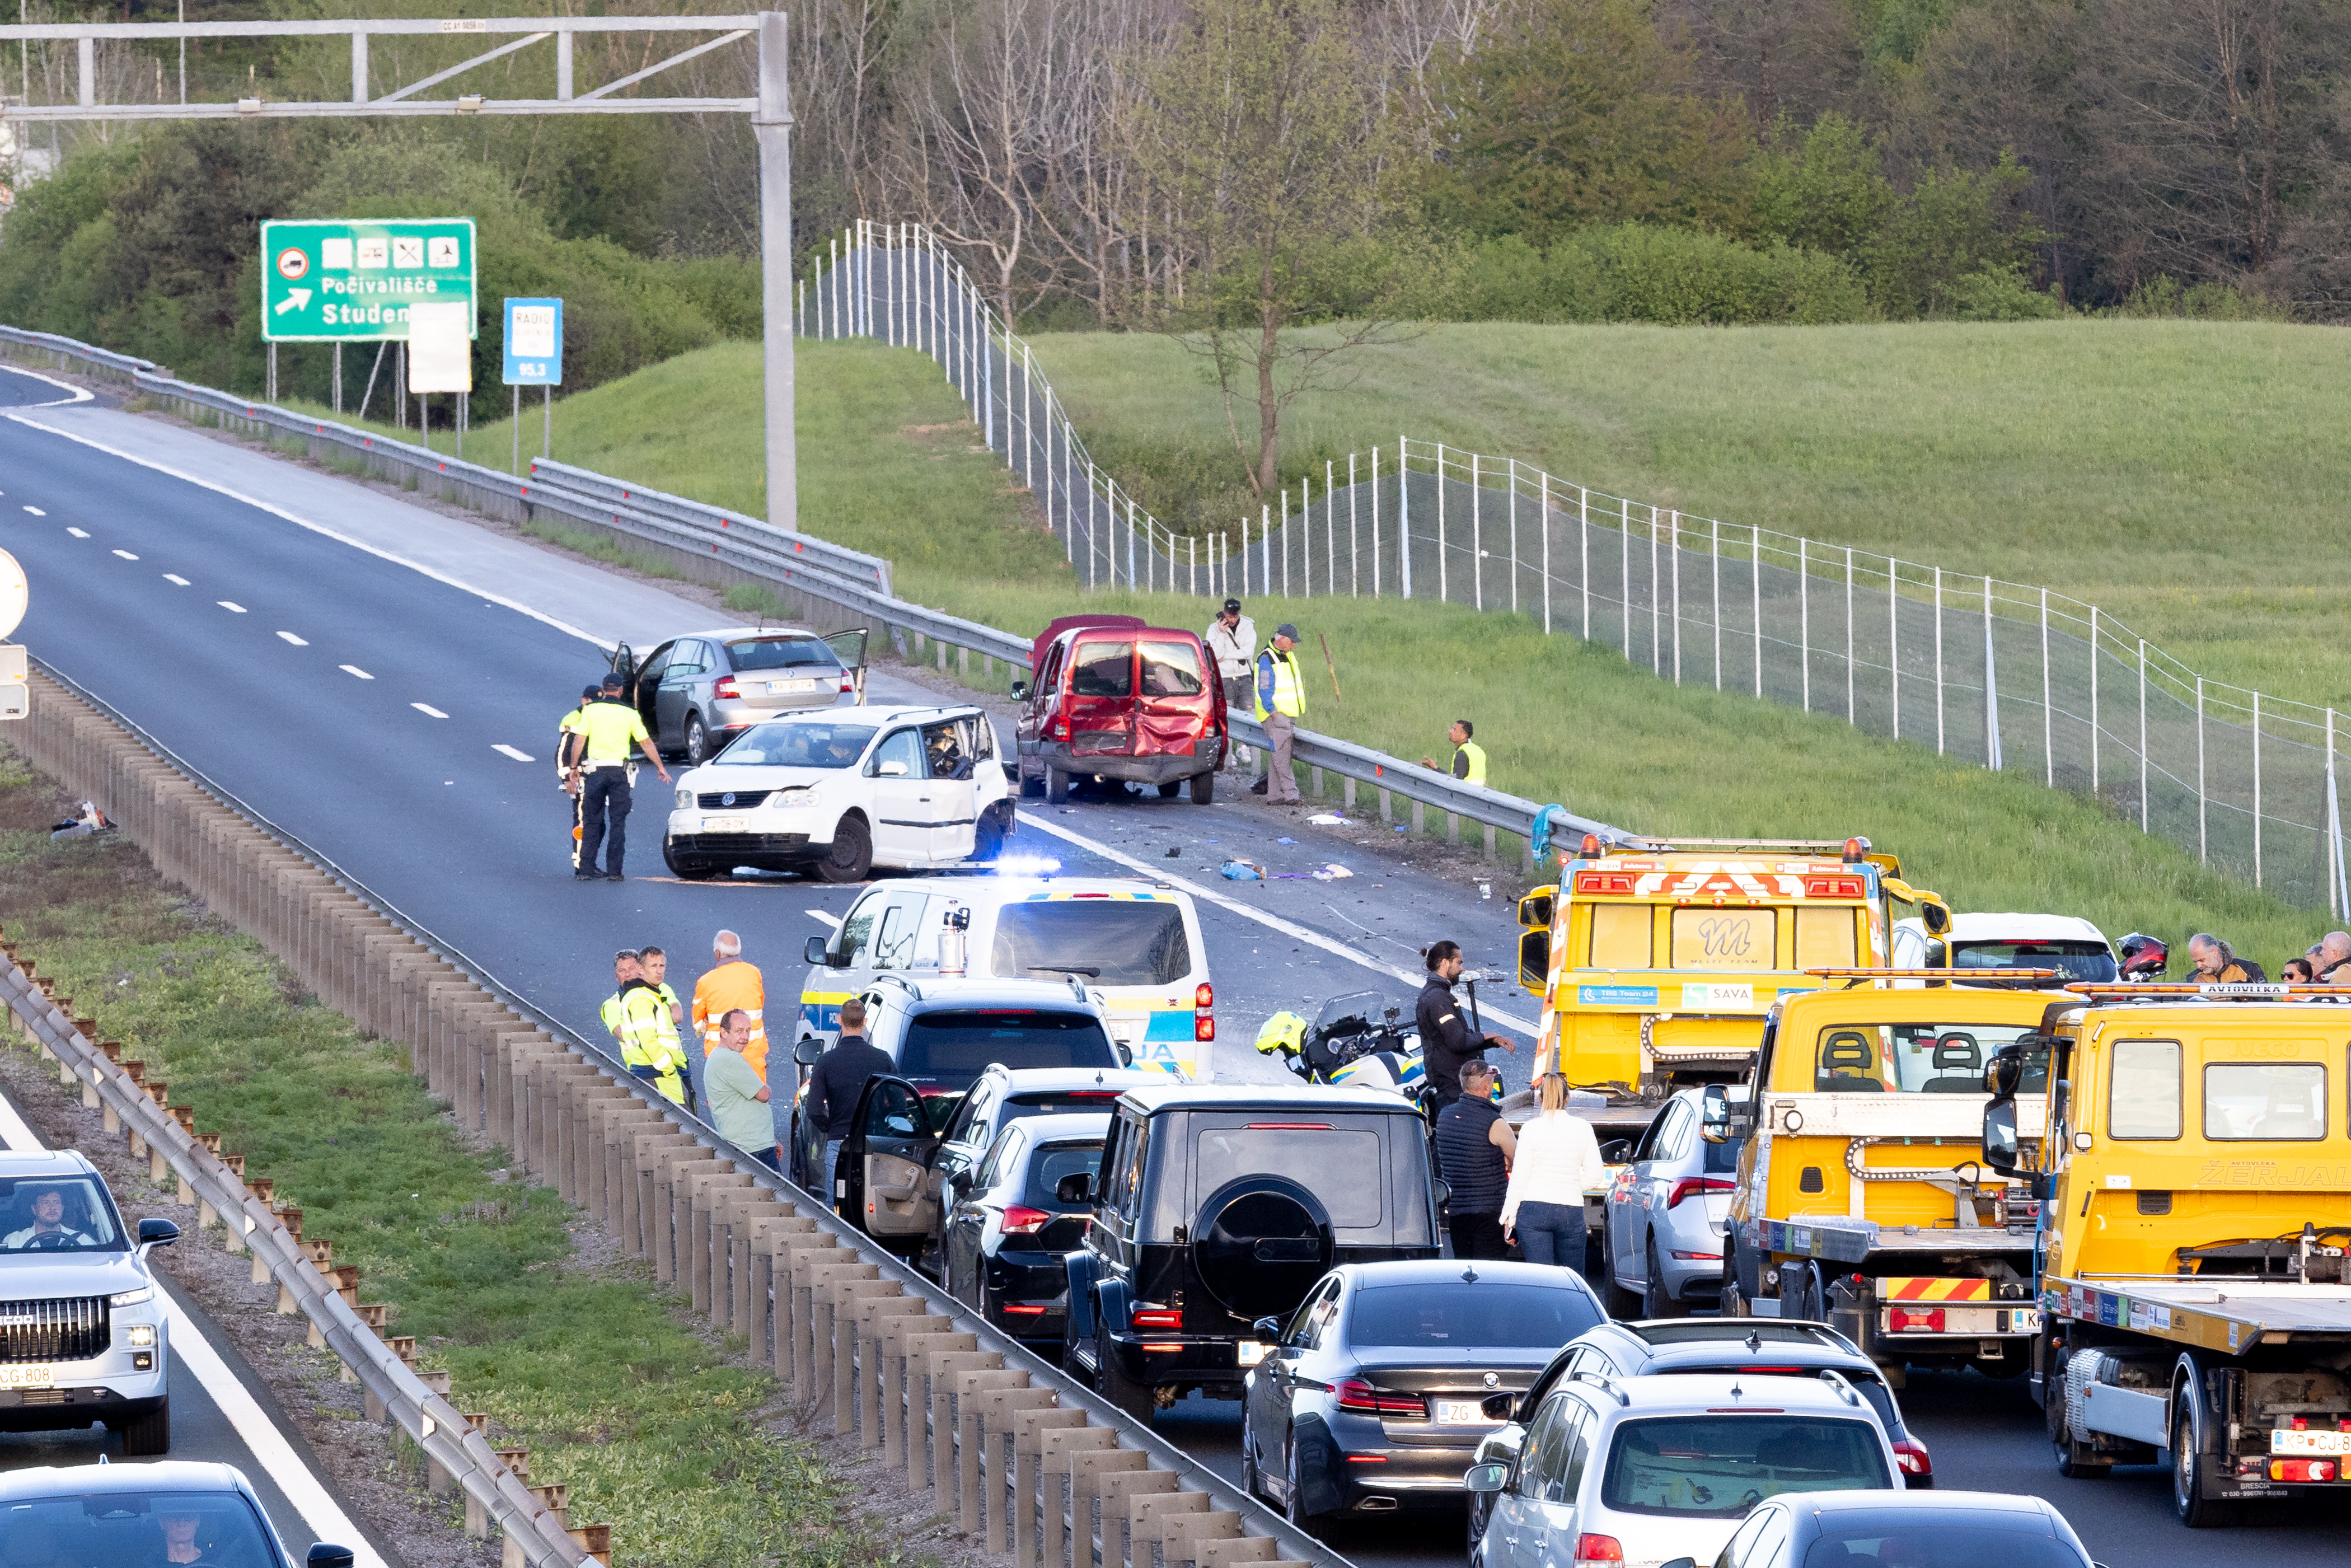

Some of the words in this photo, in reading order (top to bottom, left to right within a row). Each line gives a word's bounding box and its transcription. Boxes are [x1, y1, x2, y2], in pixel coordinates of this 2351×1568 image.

[321, 276, 438, 294] Počivališče
[516, 312, 550, 324] RADIO
[519, 362, 547, 377] 95.3
[1714, 989, 1749, 999] SAVA
[2230, 1040, 2300, 1057] IVECO
[2197, 1160, 2351, 1186] ŽERJAL
[1451, 1406, 1468, 1420] ZG
[2287, 1435, 2305, 1449] KP
